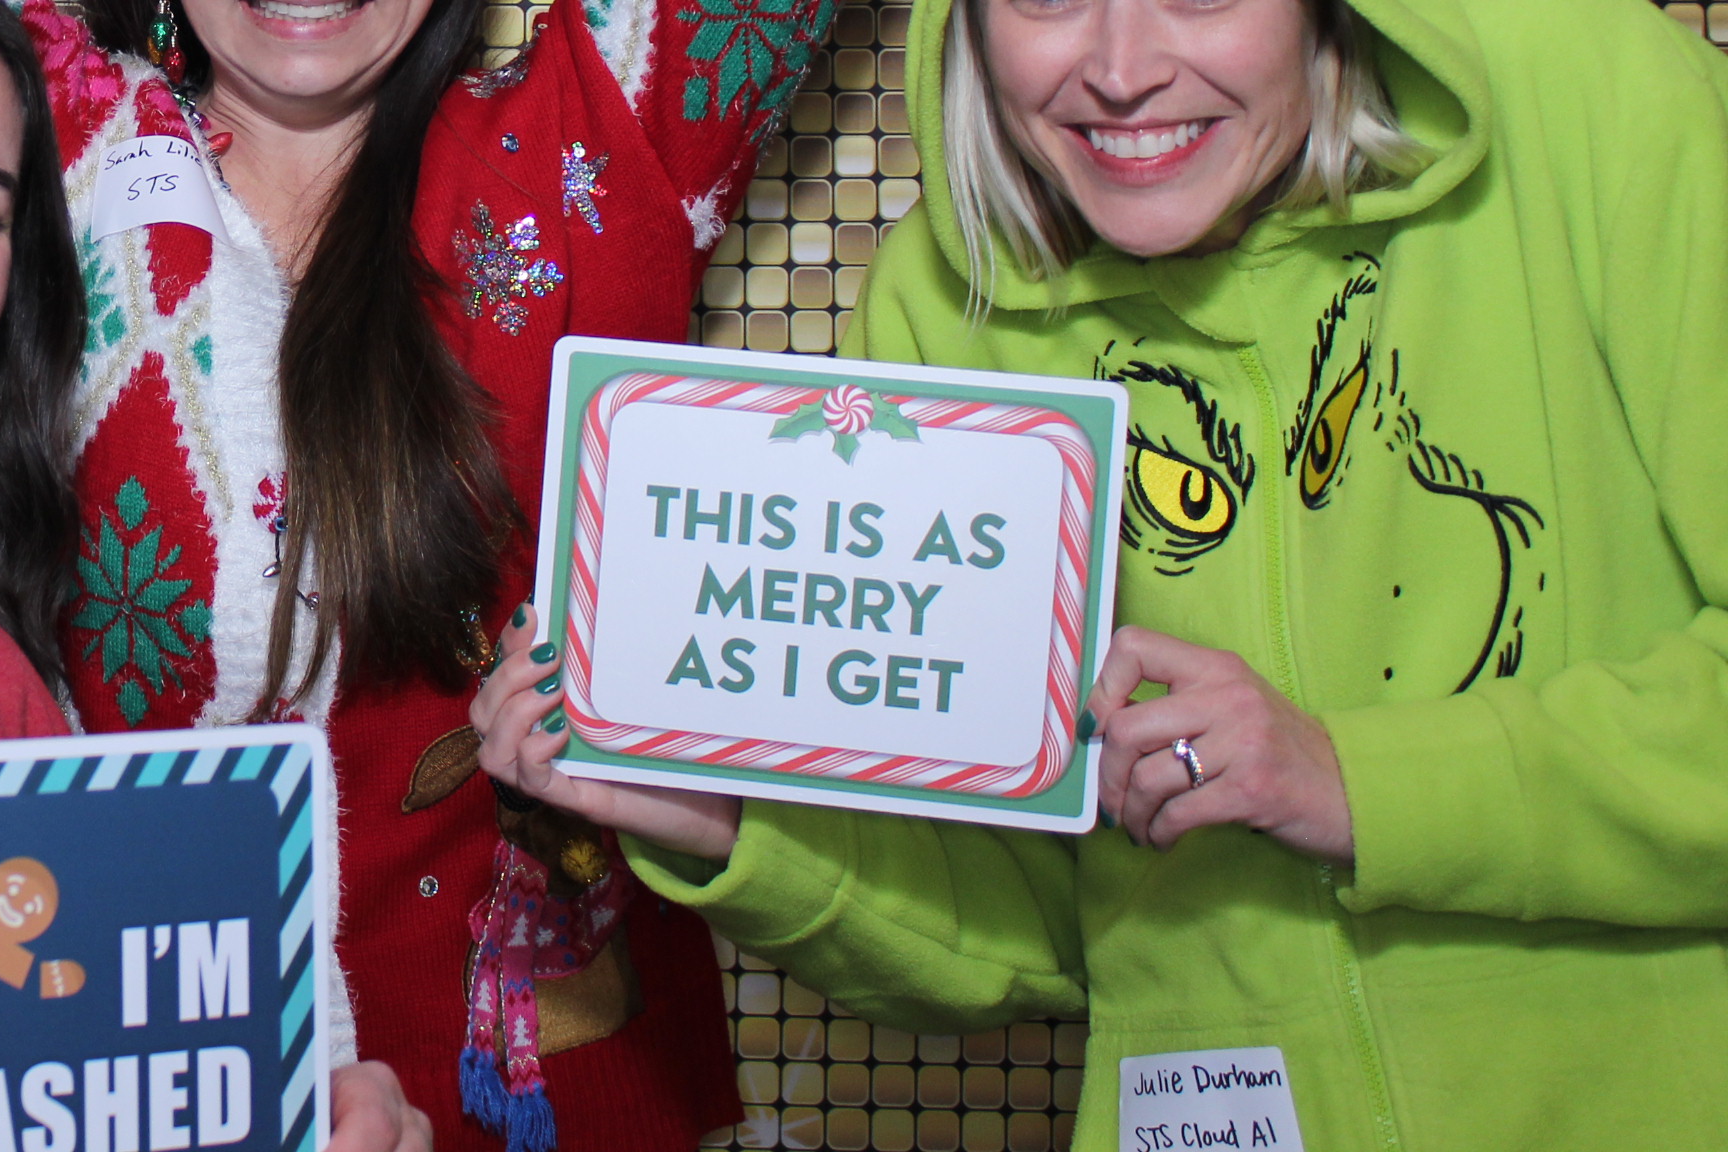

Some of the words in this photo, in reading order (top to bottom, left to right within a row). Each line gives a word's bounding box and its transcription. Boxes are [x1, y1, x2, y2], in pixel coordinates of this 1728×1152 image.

[103, 140, 152, 170] Sarah
[127, 173, 179, 201] STS
[646, 484, 799, 551] THIS
[824, 500, 886, 559] IS
[913, 509, 1009, 570] AS
[694, 561, 944, 637] MERRY
[665, 634, 757, 694] AS
[782, 644, 800, 697] I
[826, 649, 965, 713] GET
[120, 917, 250, 1029] I'M
[1134, 1069, 1184, 1096] Julie
[1192, 1063, 1282, 1094] Durham
[1135, 1123, 1174, 1152] STS
[1181, 1119, 1240, 1149] Cloud
